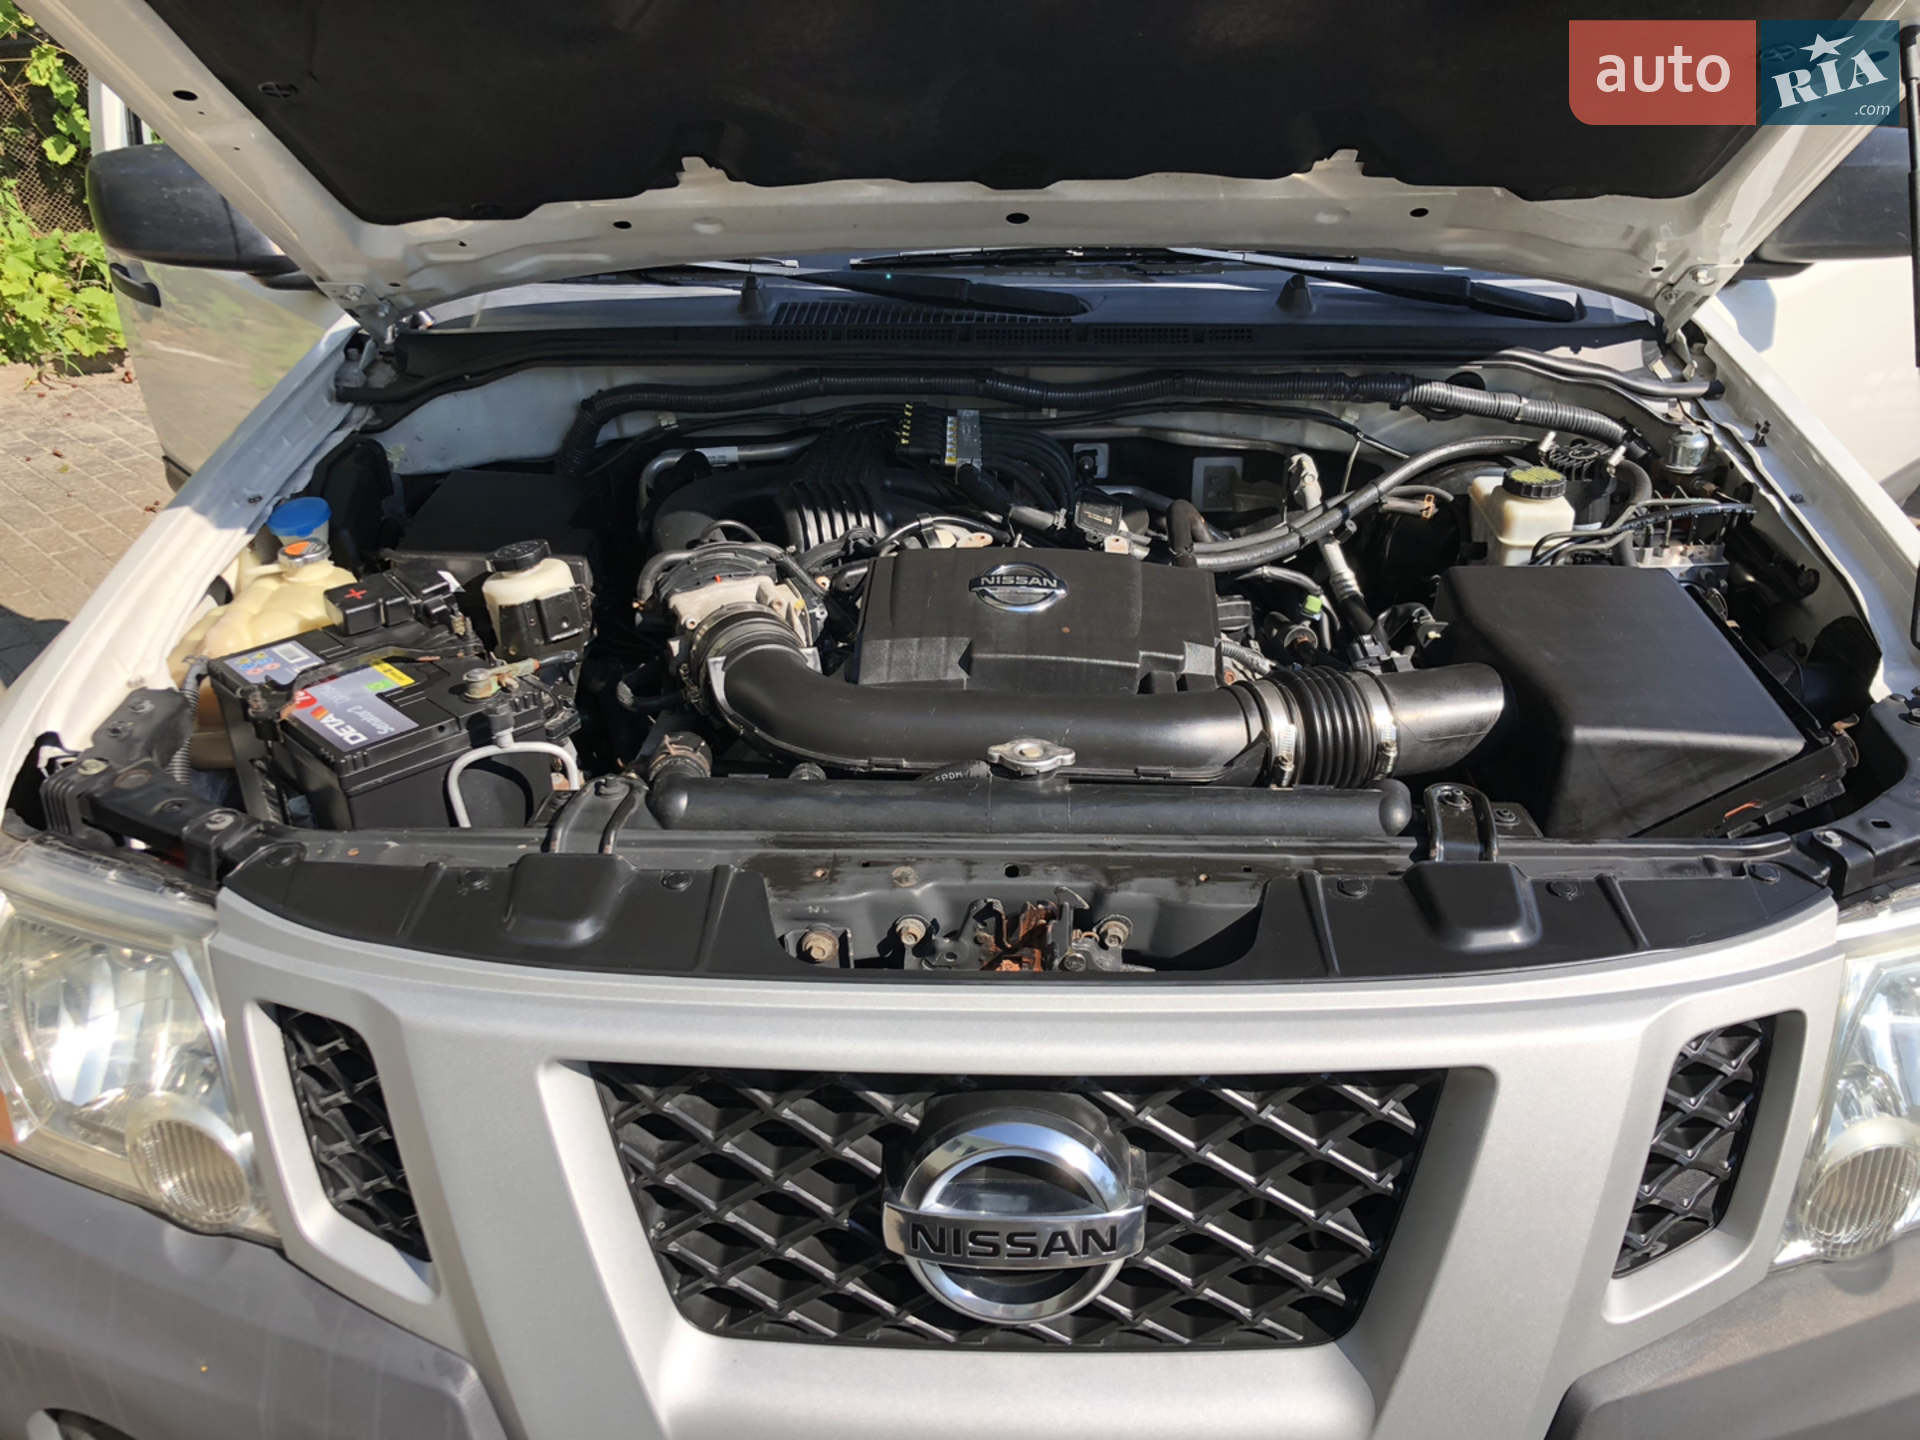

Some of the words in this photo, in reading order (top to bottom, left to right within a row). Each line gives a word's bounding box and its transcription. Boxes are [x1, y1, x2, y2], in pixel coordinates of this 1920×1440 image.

[980, 575, 1058, 589] NISSAN
[319, 713, 368, 745] DETA
[910, 1222, 1118, 1260] NISSAN
